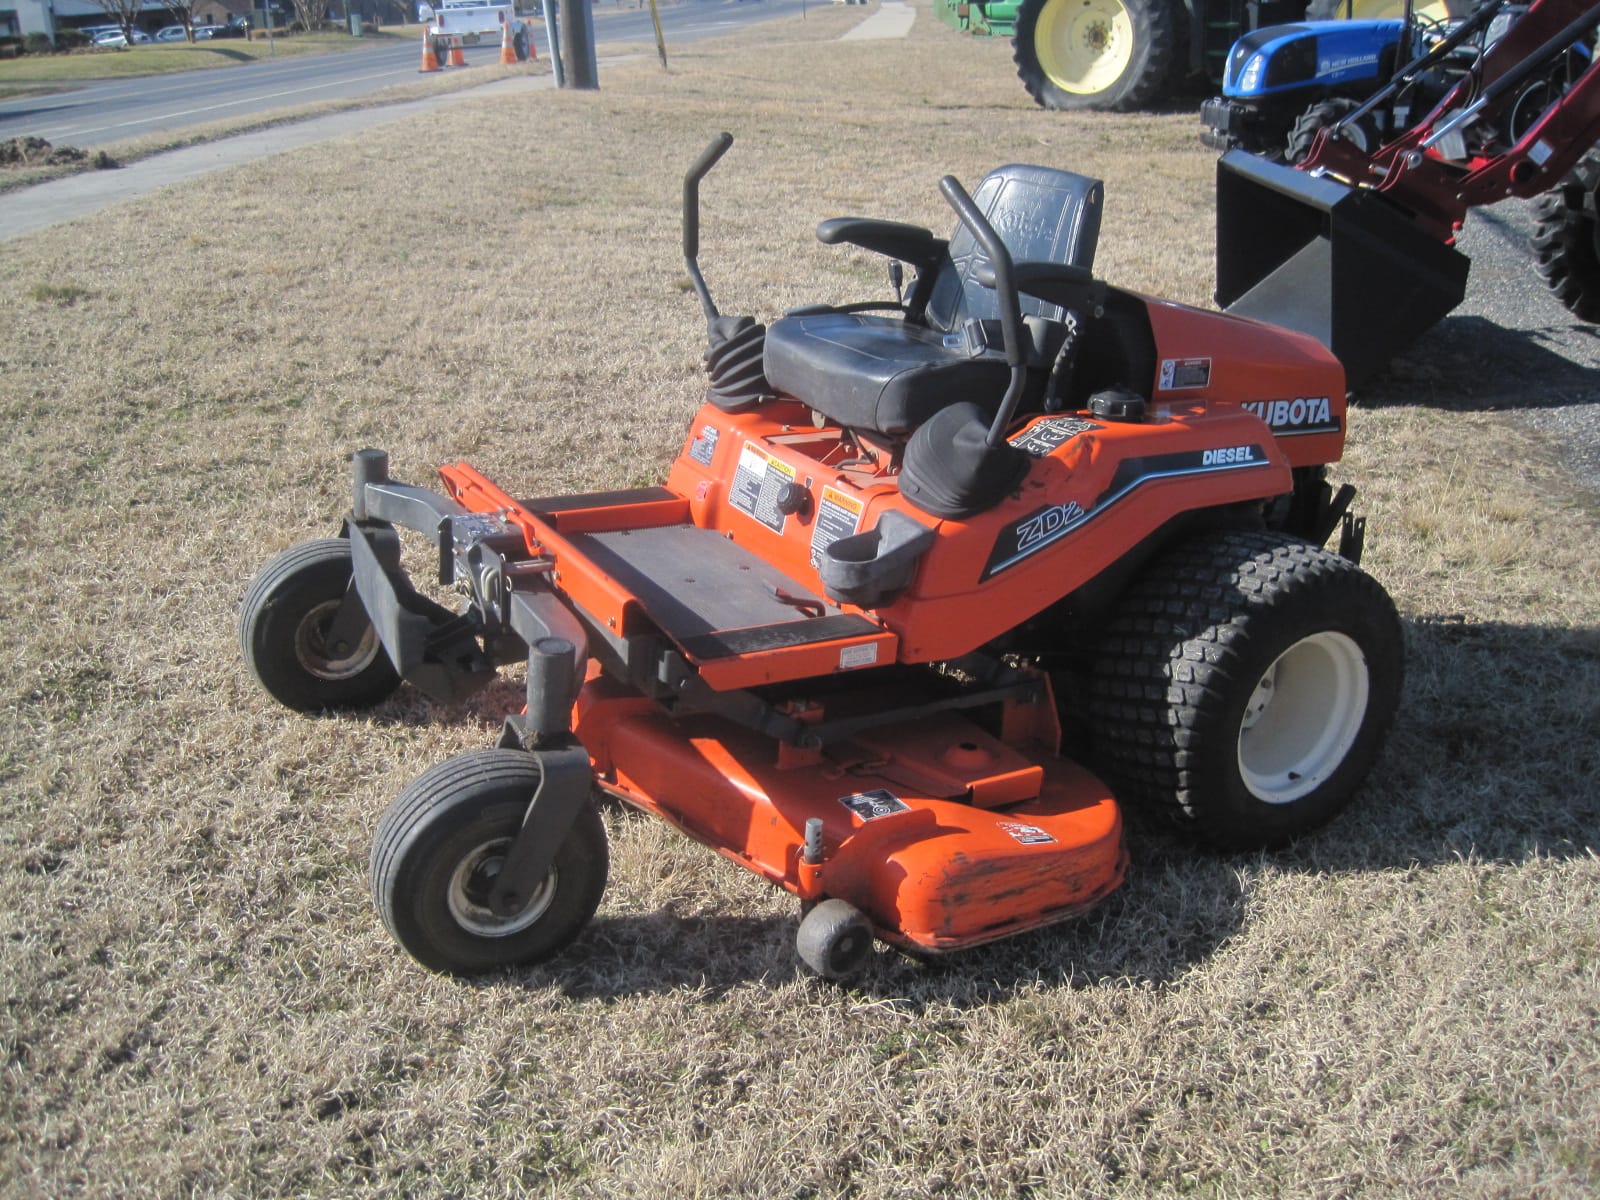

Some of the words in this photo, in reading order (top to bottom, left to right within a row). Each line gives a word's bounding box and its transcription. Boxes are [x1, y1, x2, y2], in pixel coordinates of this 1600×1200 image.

[1331, 59, 1346, 69] NEW
[1347, 54, 1377, 66] HOLLAND
[1202, 445, 1254, 465] DIESEL
